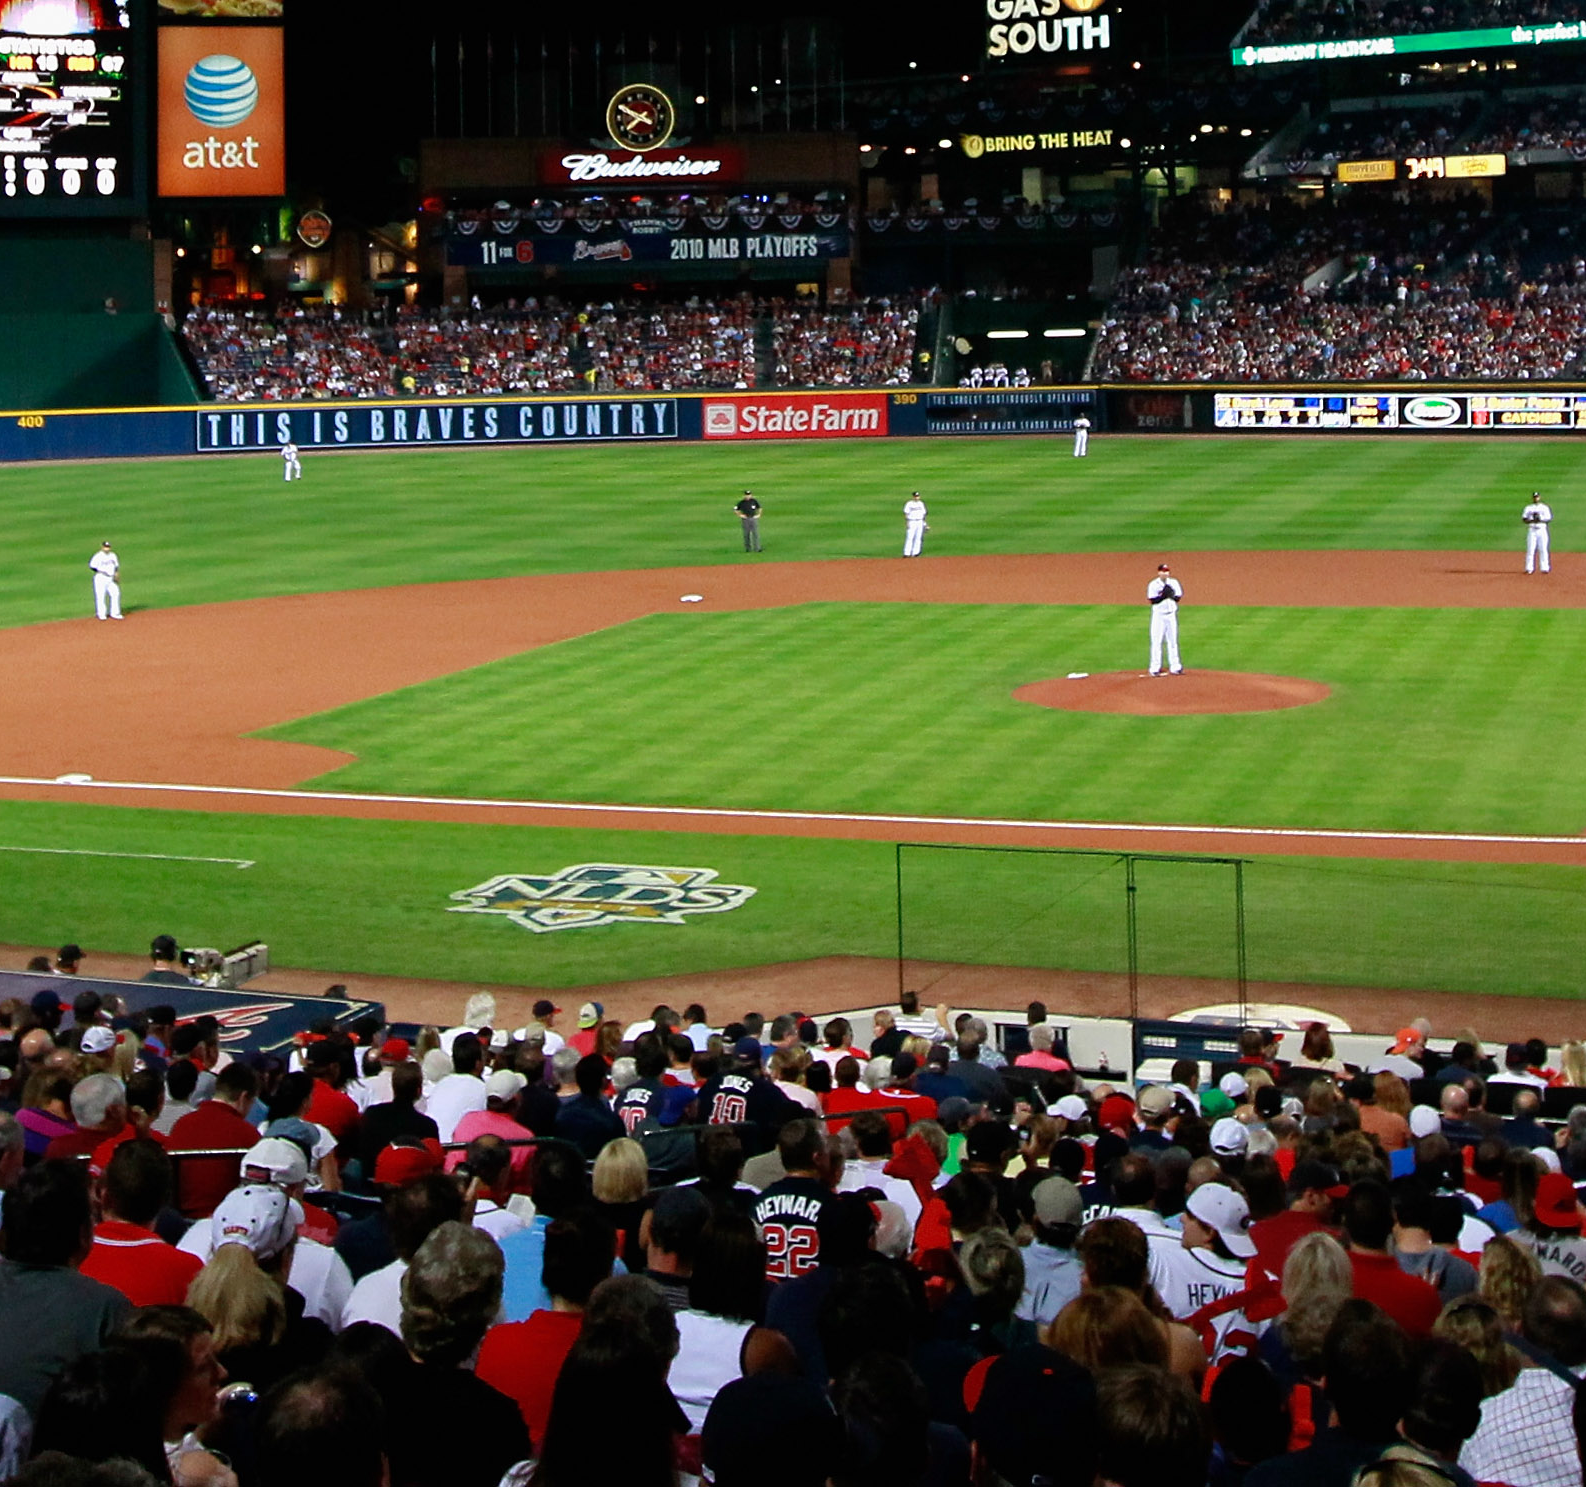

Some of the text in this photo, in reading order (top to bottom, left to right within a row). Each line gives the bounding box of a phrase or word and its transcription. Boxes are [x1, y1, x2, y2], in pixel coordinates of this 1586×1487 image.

[987, 14, 1111, 57] SOUTH
[1512, 24, 1533, 43] the
[1534, 18, 1580, 45] perfect
[1317, 37, 1395, 61] HEALTHCARE
[182, 135, 260, 170] at&t
[985, 129, 1114, 152] BRING THE HEAT
[562, 154, 720, 181] Budweiser
[481, 241, 498, 264] 11
[516, 241, 535, 263] 6
[573, 240, 627, 261] Braves
[671, 234, 818, 260] 2010 MLB PLAYOFFS
[893, 393, 917, 405] 390
[933, 395, 946, 405] THE
[17, 416, 44, 429] 400
[207, 403, 669, 446] THIS IS BRAVES COUNTRY
[1137, 415, 1173, 428] zero
[1500, 412, 1563, 424] CATCHER
[469, 876, 741, 909] NLDS
[718, 1074, 754, 1094] JONES
[708, 1092, 748, 1125] 10
[755, 1194, 823, 1223] HEYWAR
[763, 1223, 821, 1279] 22
